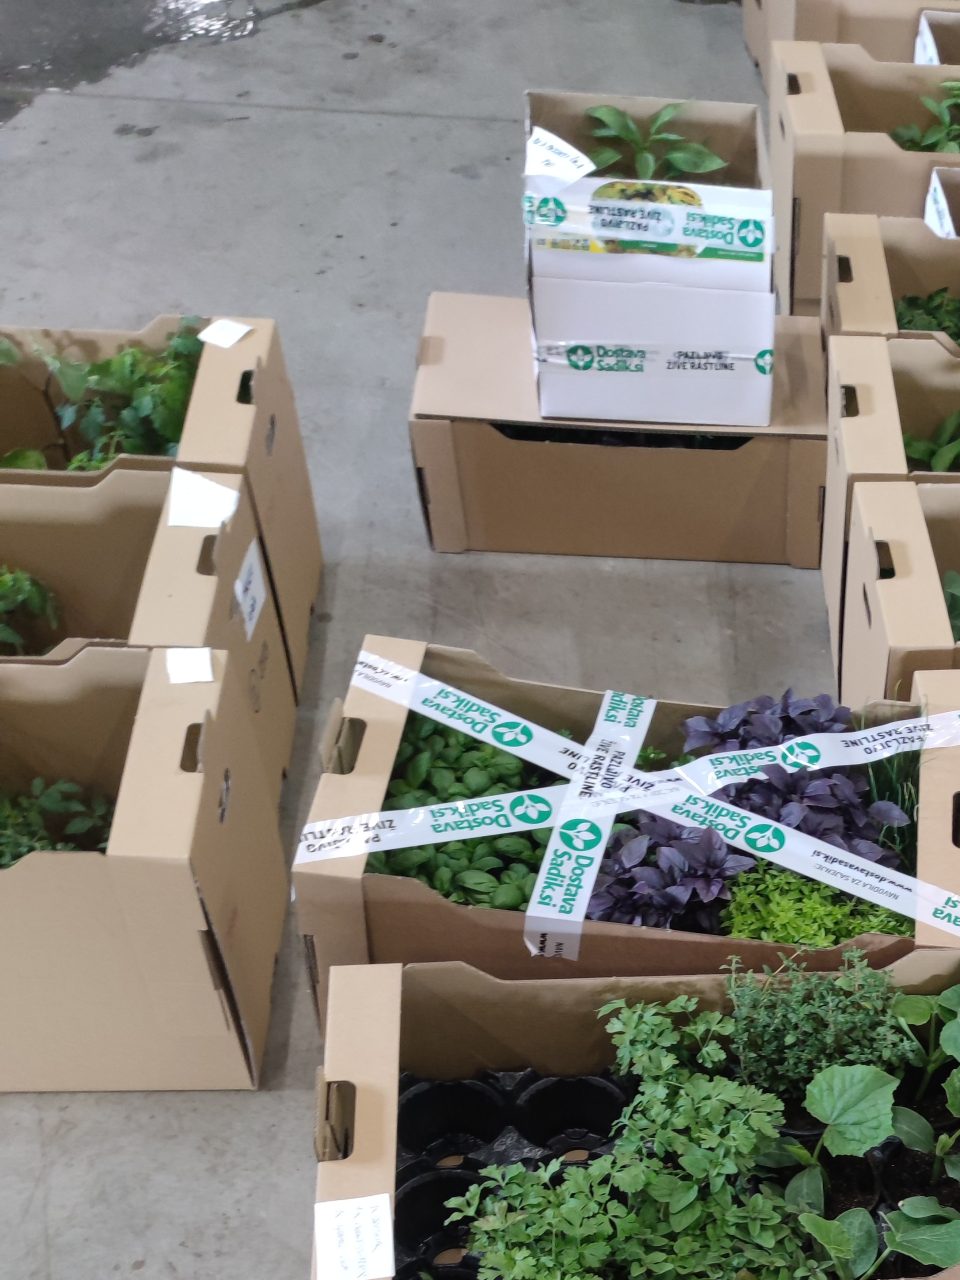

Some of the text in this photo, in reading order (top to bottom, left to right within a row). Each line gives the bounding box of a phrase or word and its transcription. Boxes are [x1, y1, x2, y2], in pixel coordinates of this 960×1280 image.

[682, 226, 734, 245] Dostava
[596, 345, 645, 359] Dostava
[421, 697, 489, 734] Dostava
[714, 765, 765, 780] stava
[431, 813, 512, 834] Dostava
[671, 804, 741, 842] Dostava
[558, 854, 595, 915] Dostava
[811, 849, 913, 893] www.dostavasadik.si
